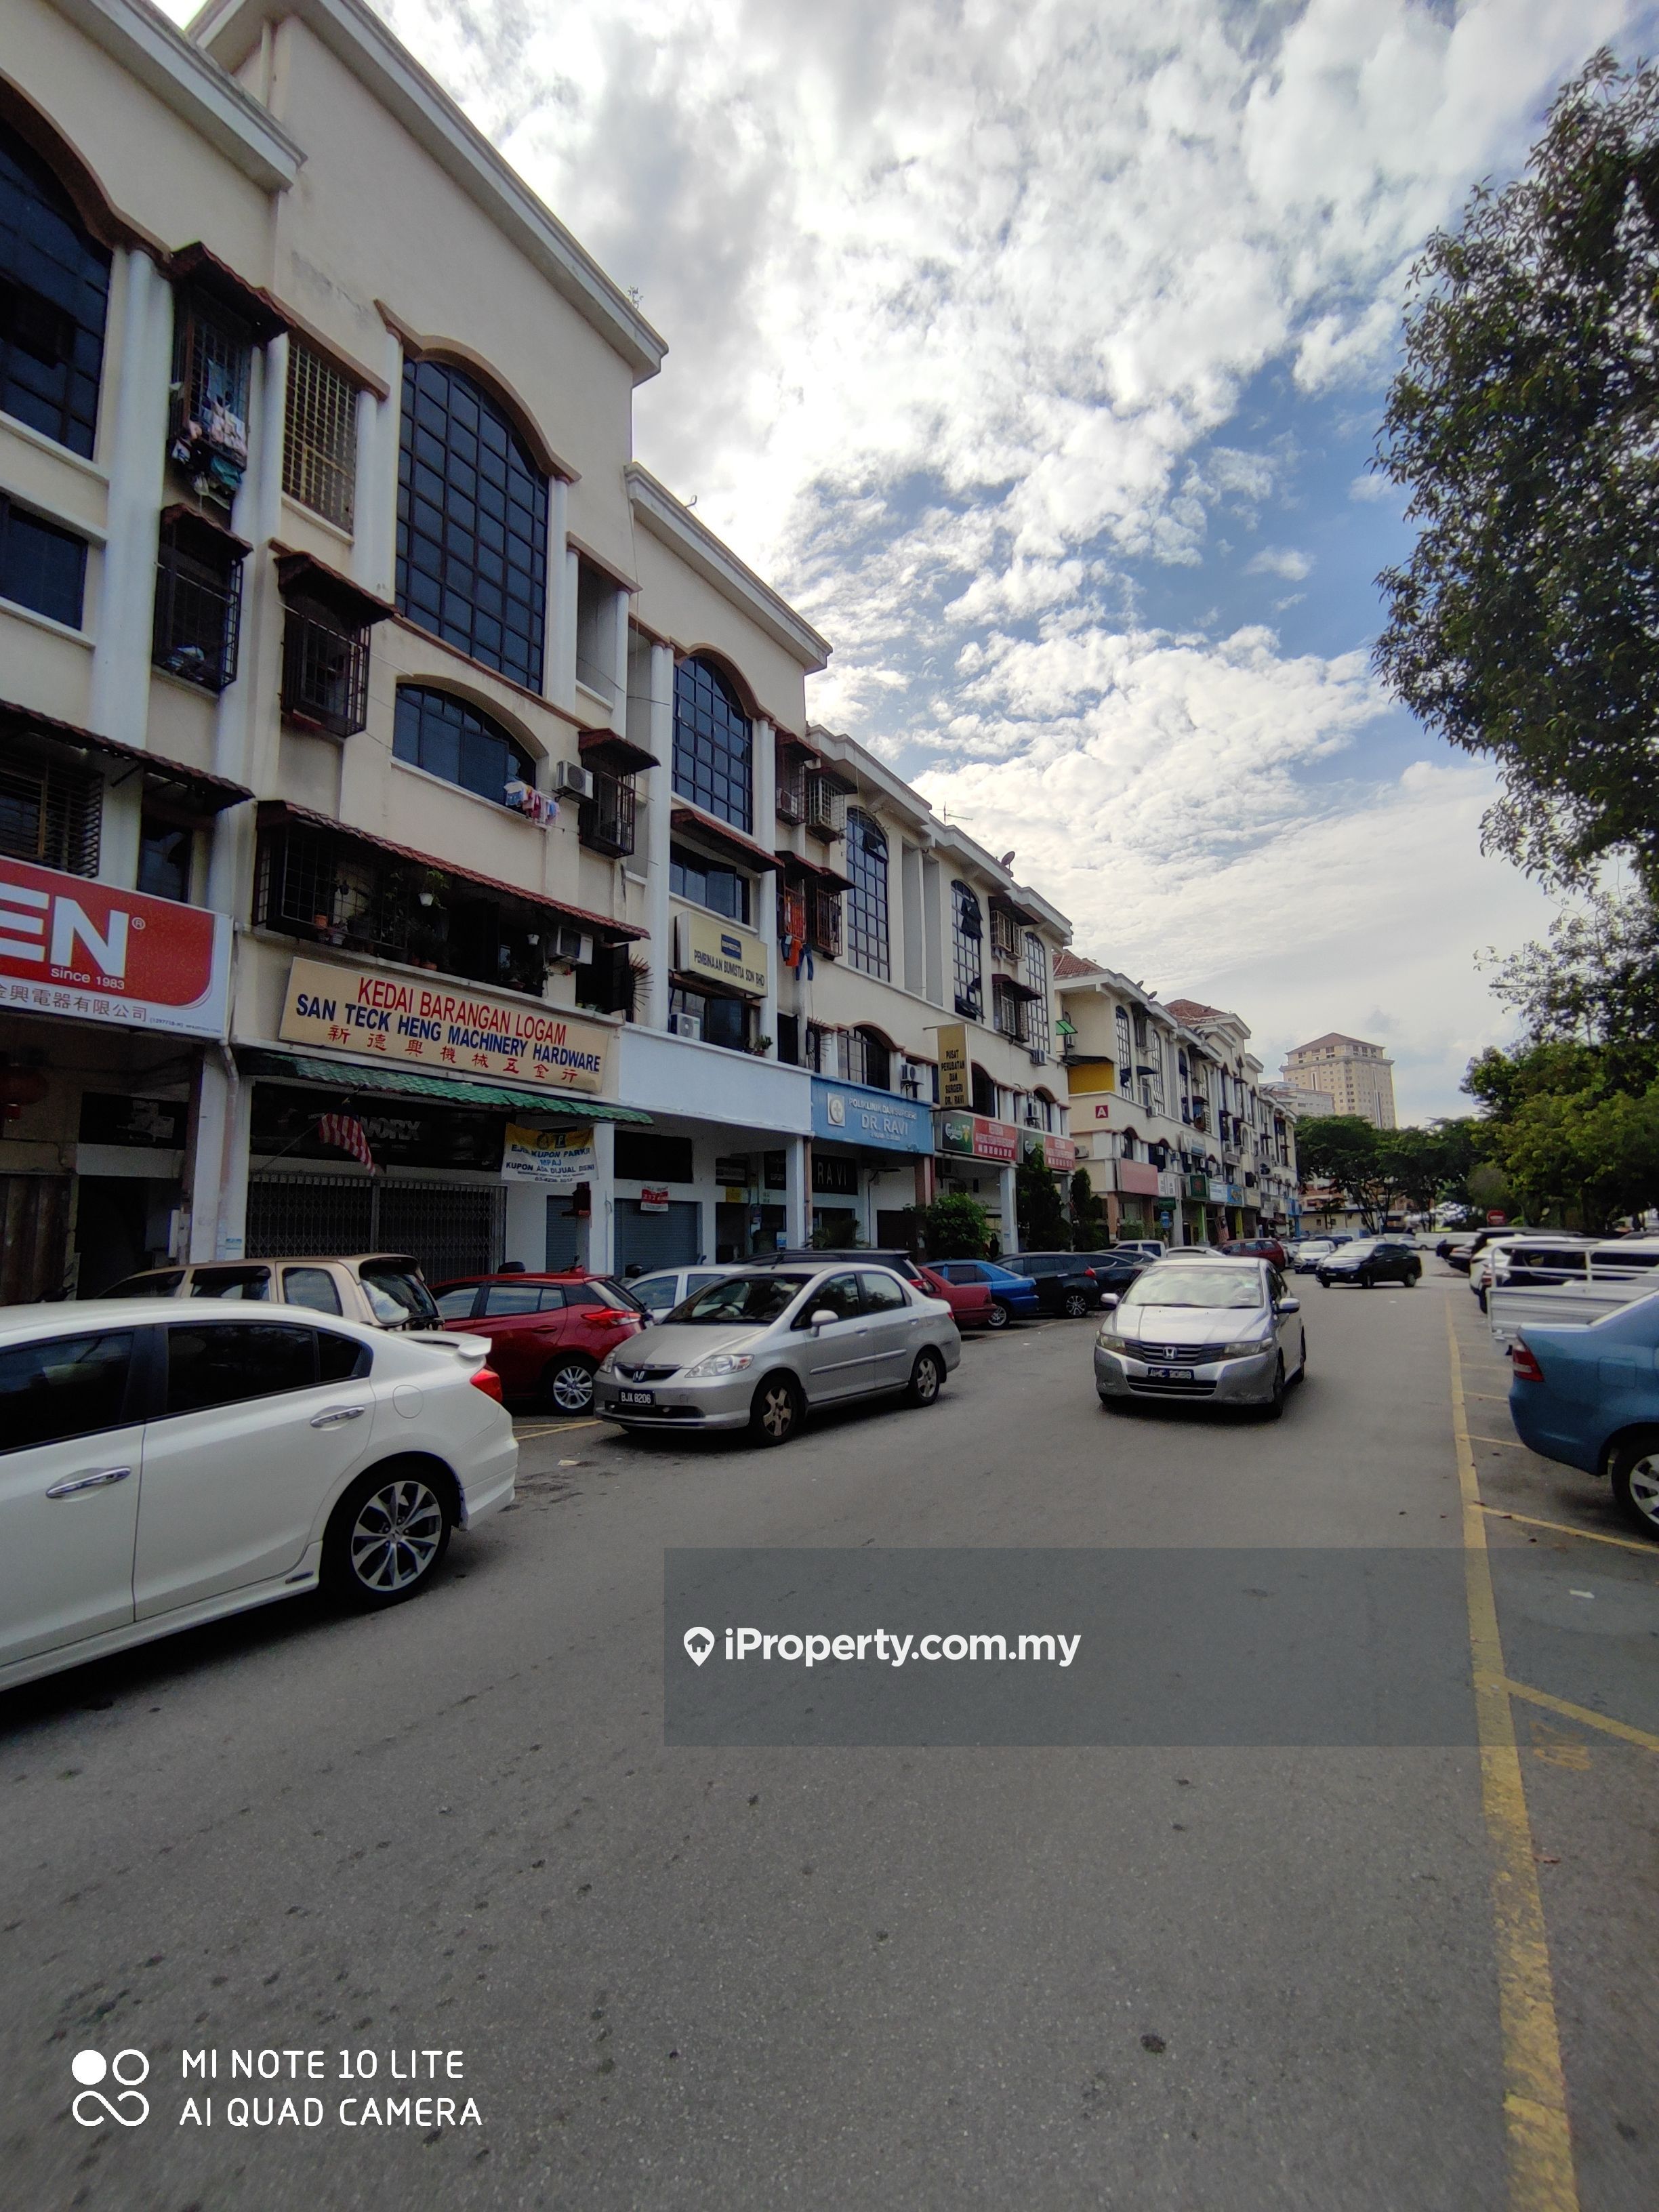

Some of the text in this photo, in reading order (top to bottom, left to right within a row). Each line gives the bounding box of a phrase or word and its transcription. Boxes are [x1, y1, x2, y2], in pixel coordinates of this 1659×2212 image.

[51, 966, 125, 990] since 1983
[745, 968, 755, 983] SDN
[755, 972, 765, 987] BHD
[357, 977, 567, 1046] KEDAI BARANGAN LOGAM
[295, 994, 602, 1073] SAN TECK HENG MACHINERY HARDWARE
[945, 1049, 960, 1059] PUSAT
[848, 1097, 882, 1113] POLIKLINIK
[1097, 1106, 1107, 1118] A
[861, 1113, 909, 1136] DR. RAVI
[531, 1150, 561, 1158] KUPON
[506, 1162, 533, 1171] KUPON
[550, 1166, 576, 1174] DIJUAL
[817, 1161, 846, 1187] RAVI
[634, 1393, 651, 1404] 8206
